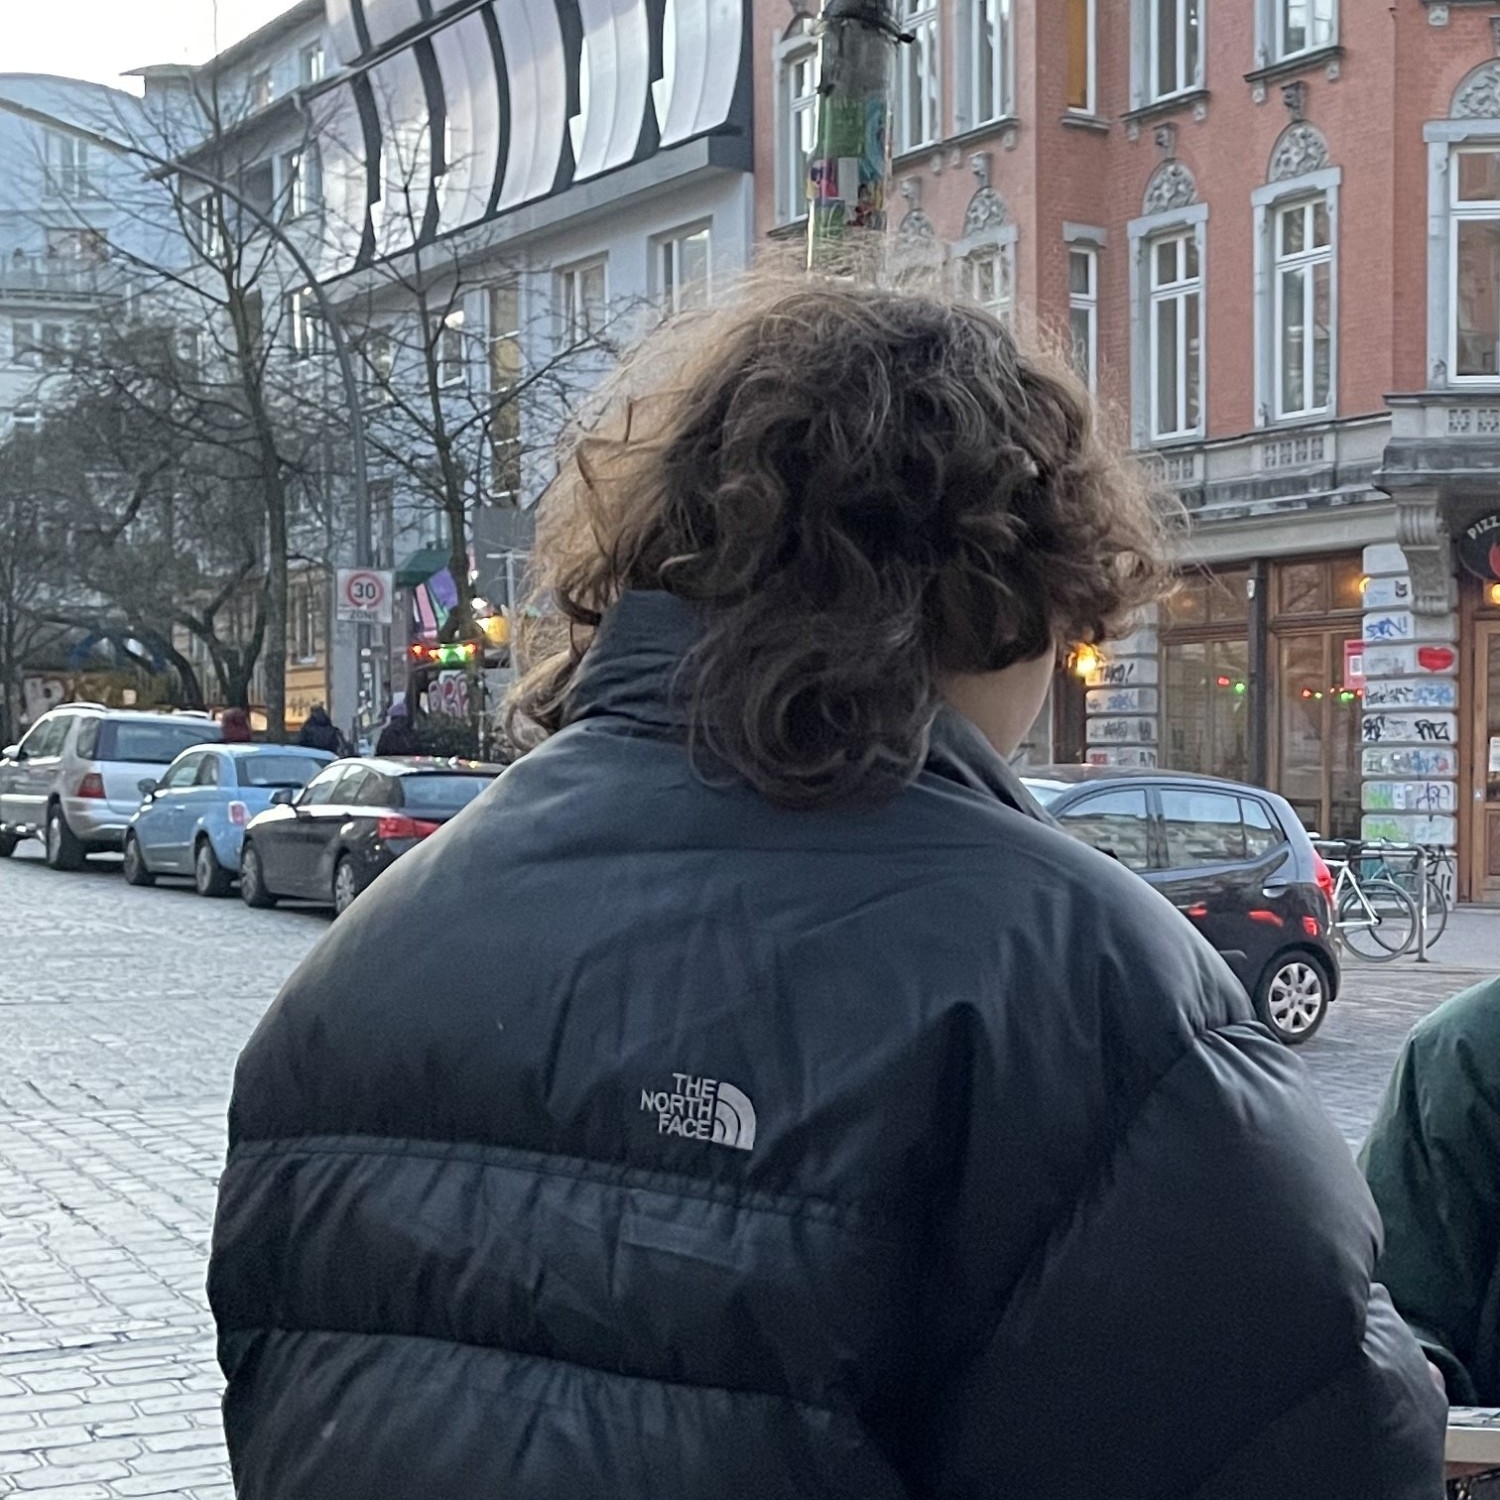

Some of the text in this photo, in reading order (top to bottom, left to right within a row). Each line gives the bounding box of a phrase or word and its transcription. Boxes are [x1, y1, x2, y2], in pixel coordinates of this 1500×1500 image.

[354, 582, 376, 600] 30
[672, 1072, 717, 1101] THE
[640, 1089, 715, 1120] NORTH
[658, 1113, 711, 1140] FACE
